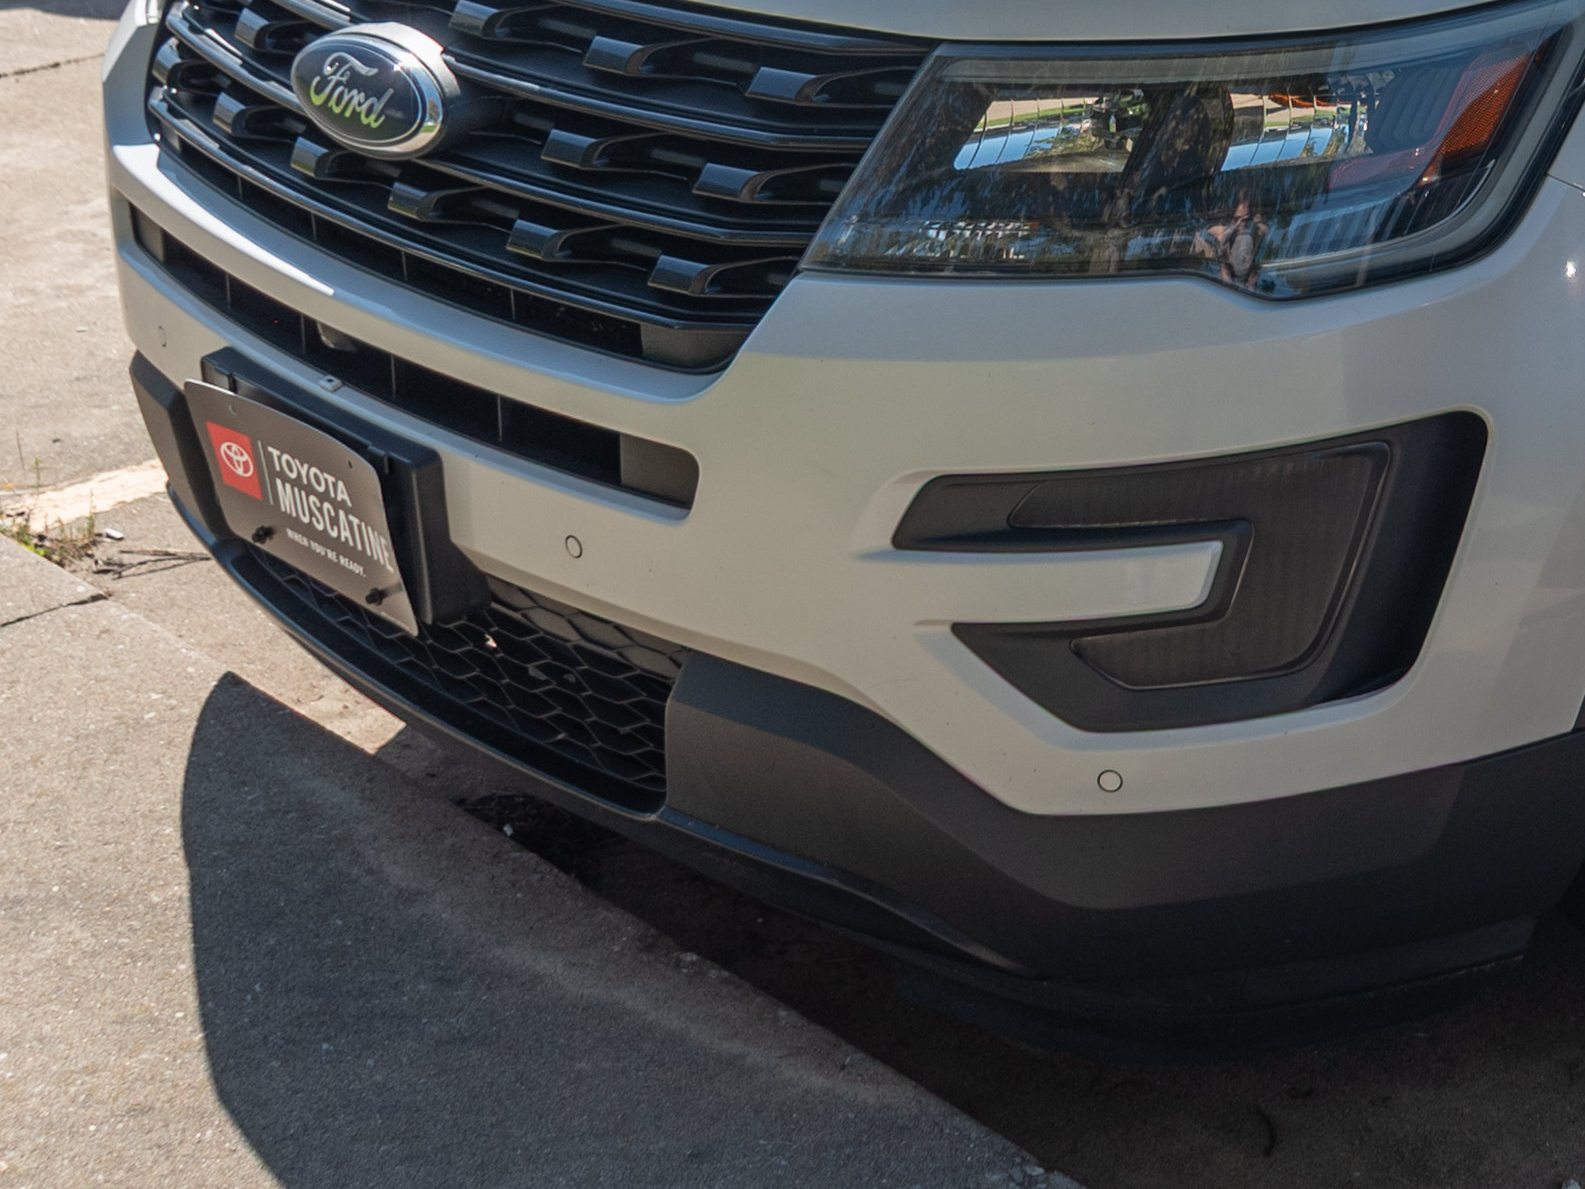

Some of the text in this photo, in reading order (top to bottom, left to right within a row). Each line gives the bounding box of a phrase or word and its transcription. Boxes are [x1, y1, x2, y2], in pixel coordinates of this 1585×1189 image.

[309, 51, 394, 129] Ford
[267, 446, 352, 508] TOYOTA
[275, 477, 395, 573] MUSCATINE
